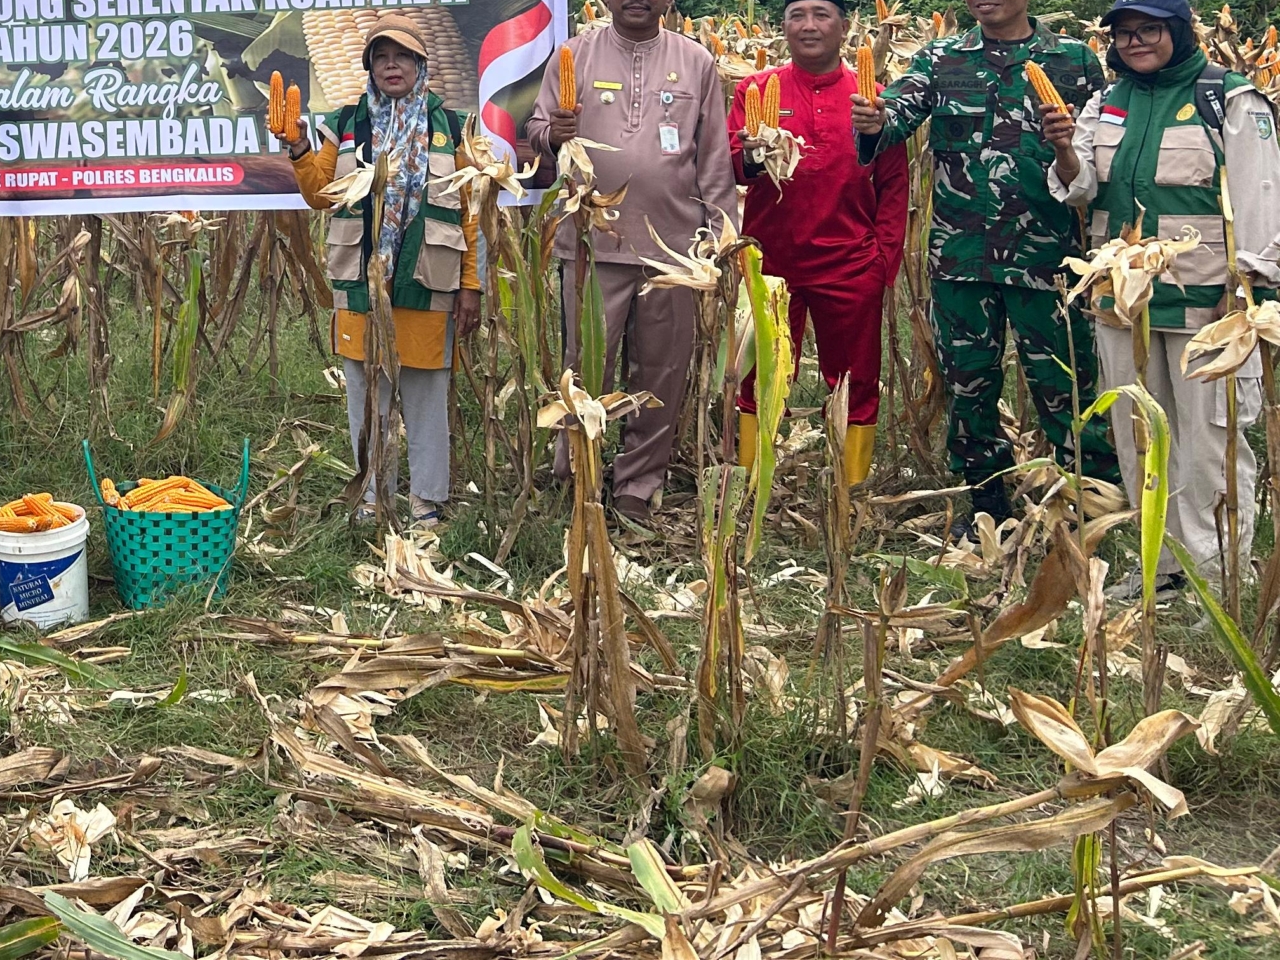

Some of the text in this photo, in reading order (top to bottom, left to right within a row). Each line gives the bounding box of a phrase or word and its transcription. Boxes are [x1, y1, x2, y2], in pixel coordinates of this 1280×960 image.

[95, 19, 195, 60] 2026
[83, 62, 223, 121] Rangka
[5, 171, 59, 187] RUPAT
[71, 169, 136, 186] POLRES
[138, 166, 235, 184] BENGKALIS
[12, 578, 44, 593] NATURAL
[19, 587, 43, 600] MICRO
[18, 593, 50, 609] MINERAL
